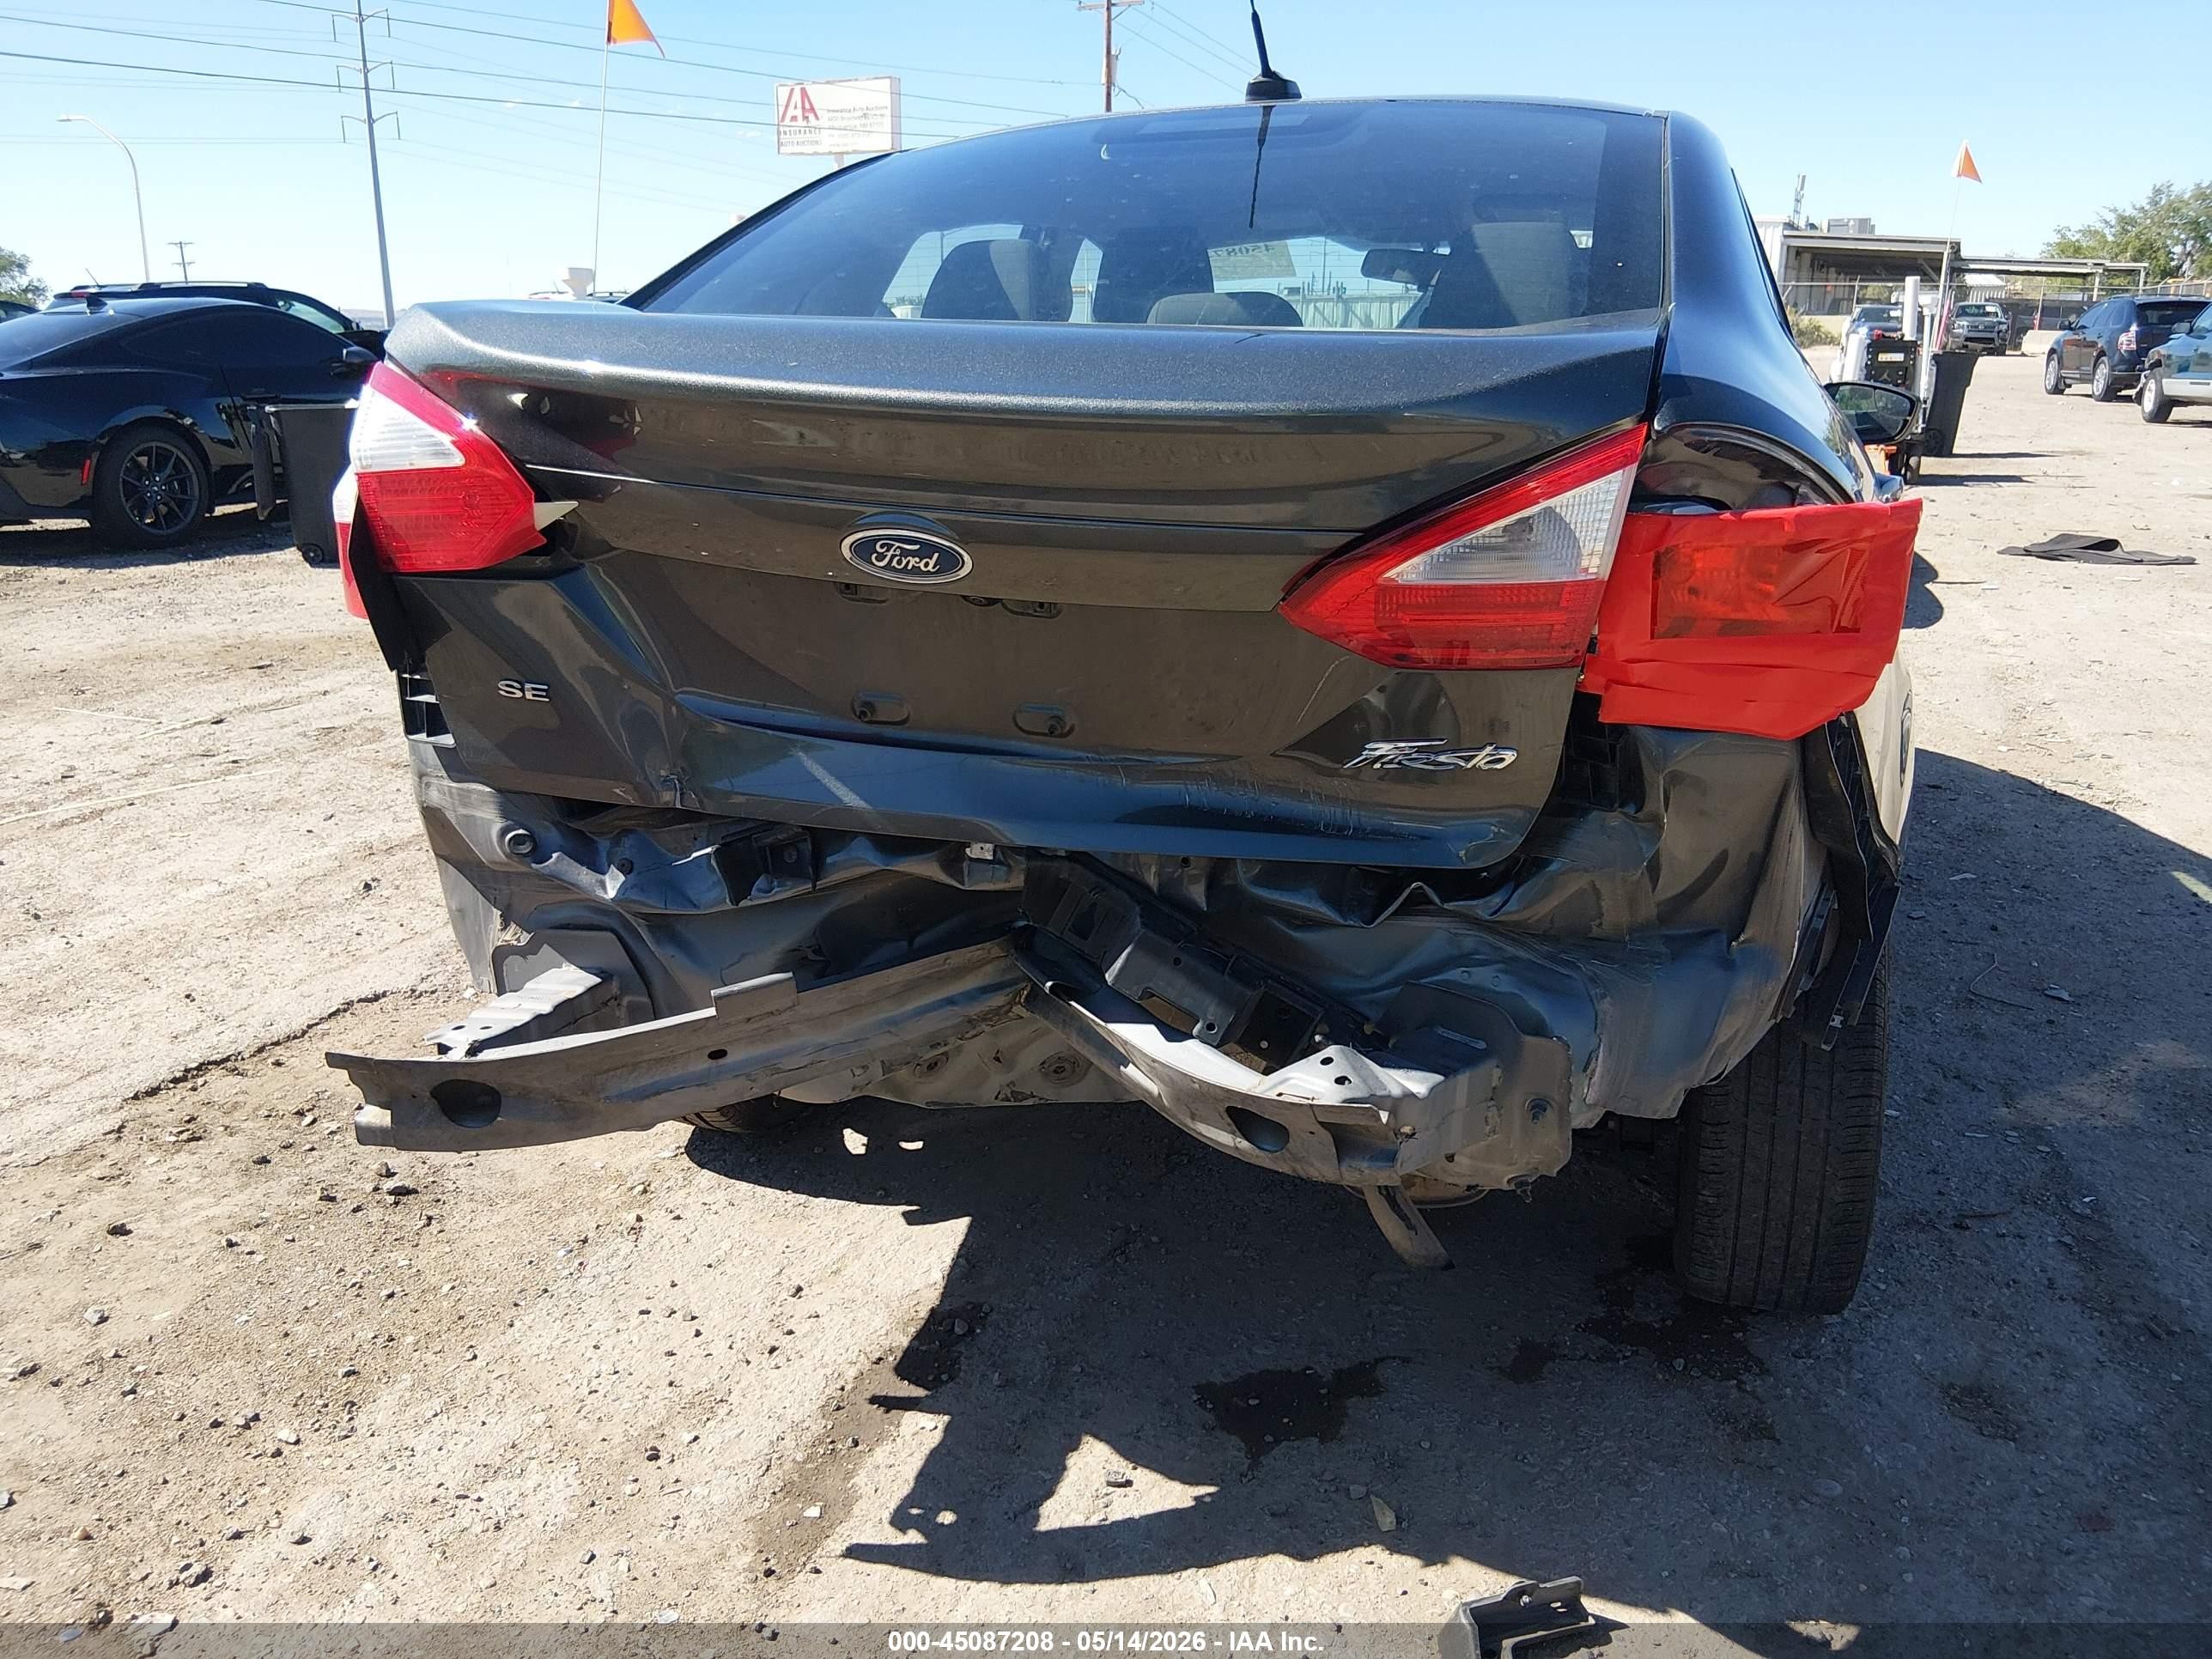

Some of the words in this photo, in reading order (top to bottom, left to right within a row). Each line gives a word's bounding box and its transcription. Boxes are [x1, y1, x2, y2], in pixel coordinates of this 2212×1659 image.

[871, 539, 940, 573] Ford
[497, 680, 550, 702] SE
[1342, 738, 1519, 770] Fiesta
